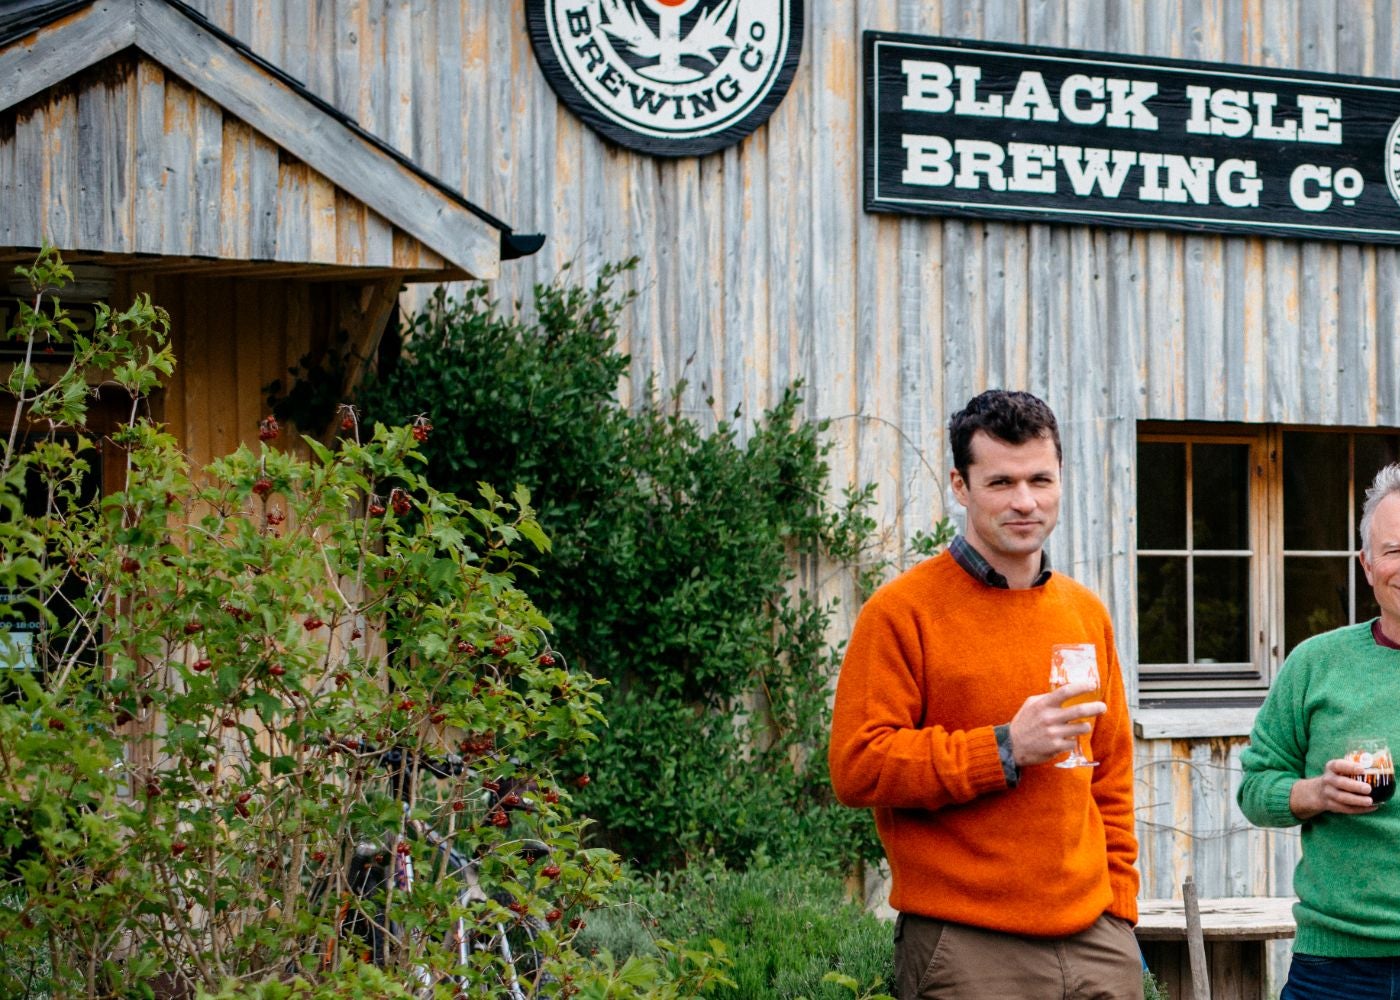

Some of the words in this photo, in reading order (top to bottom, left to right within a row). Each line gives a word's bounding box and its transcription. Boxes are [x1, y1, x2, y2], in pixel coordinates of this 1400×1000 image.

[566, 7, 743, 119] BREWING
[901, 59, 1158, 130] BLACK
[1186, 85, 1342, 144] ISLE
[901, 134, 1263, 207] BREWING
